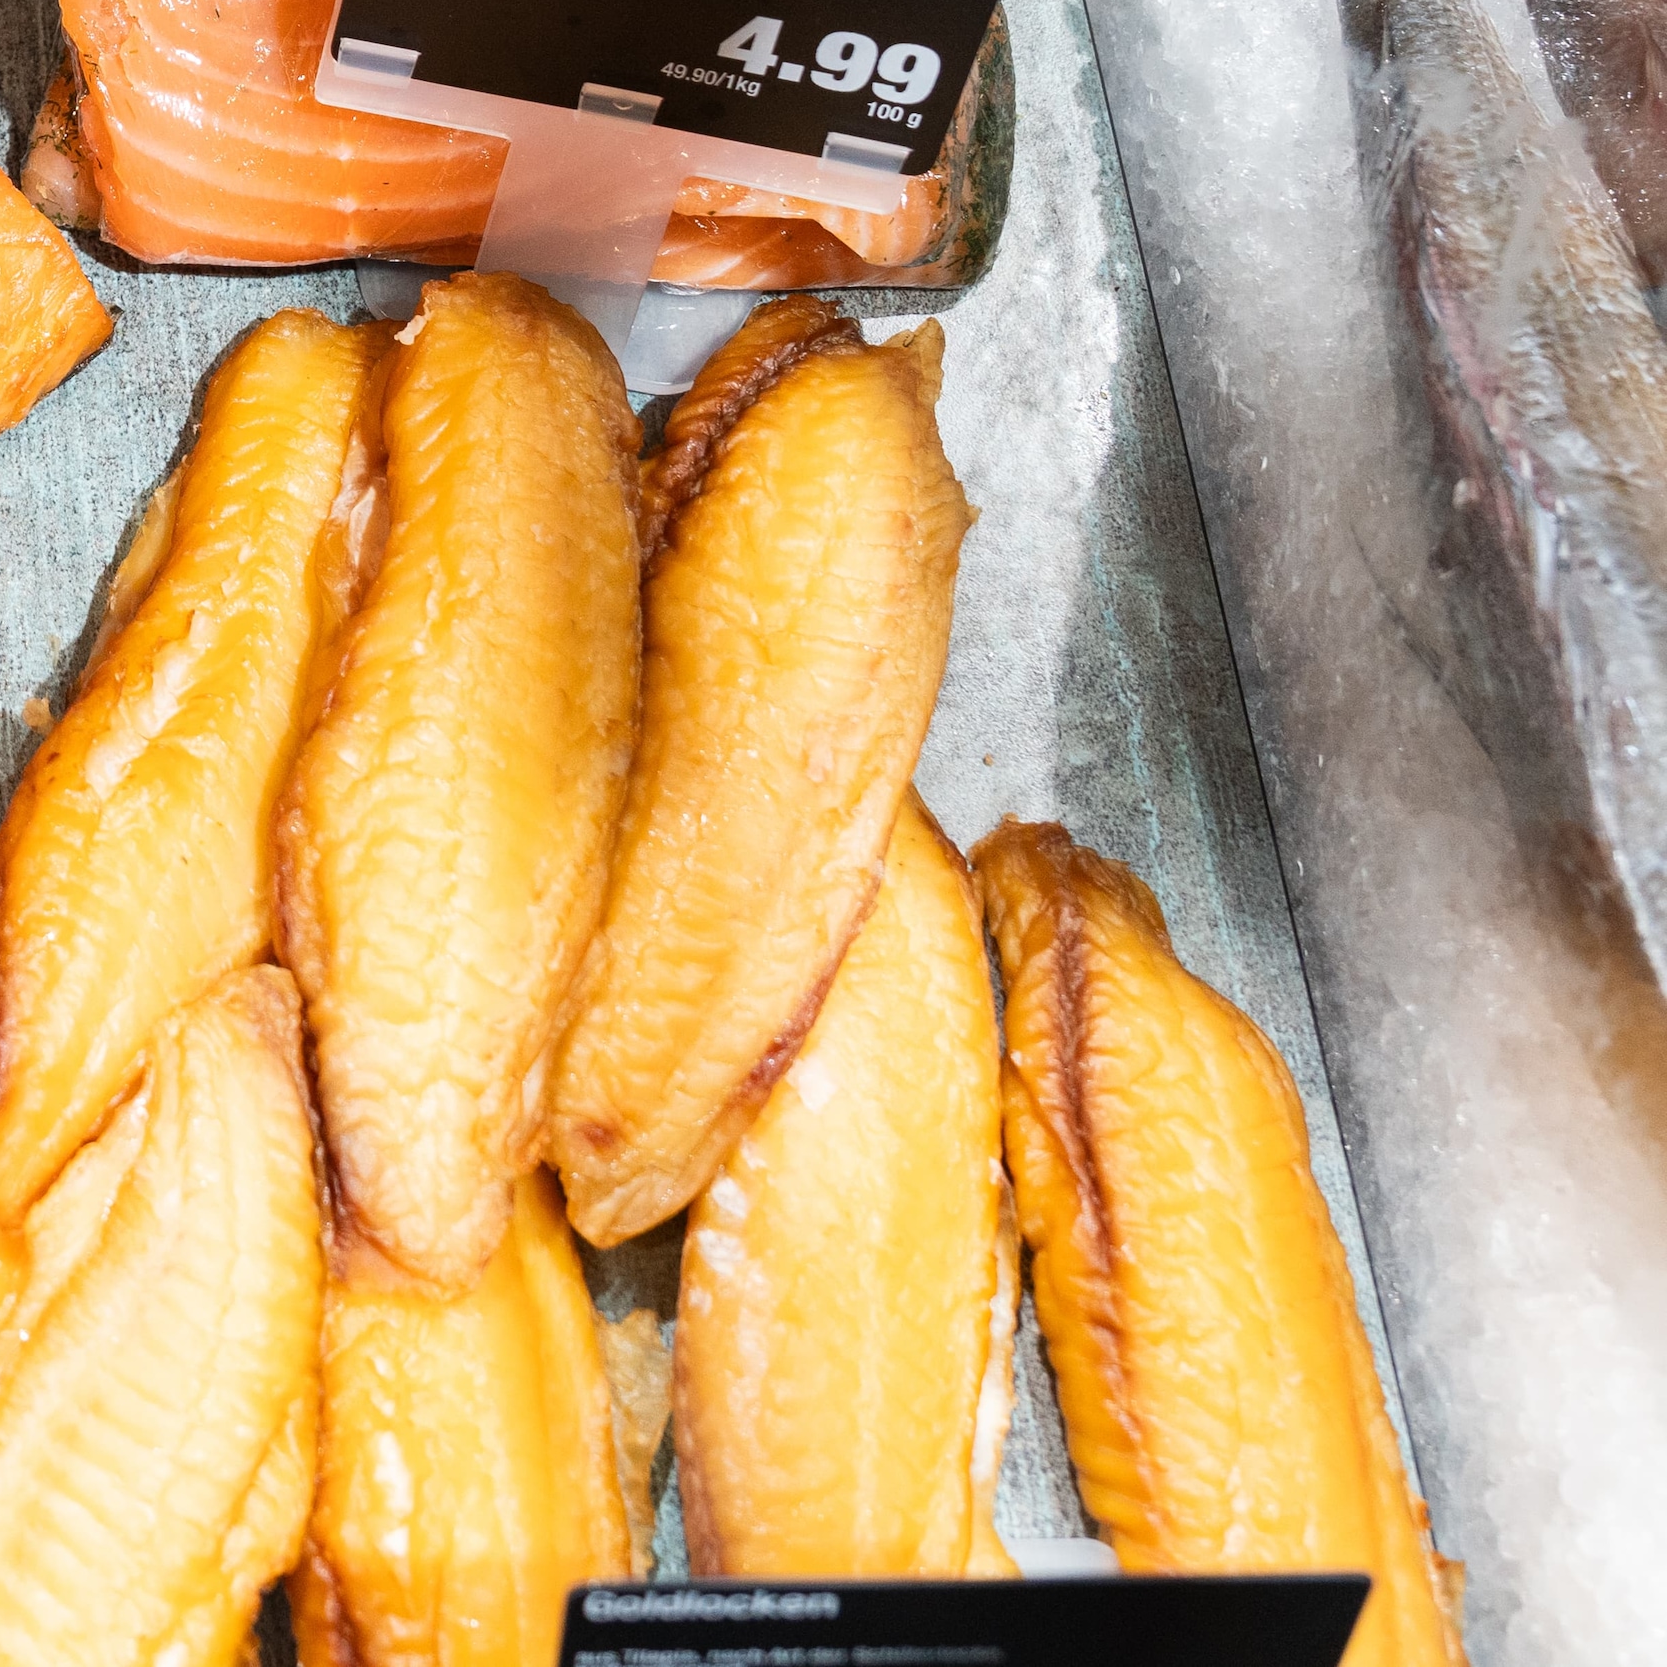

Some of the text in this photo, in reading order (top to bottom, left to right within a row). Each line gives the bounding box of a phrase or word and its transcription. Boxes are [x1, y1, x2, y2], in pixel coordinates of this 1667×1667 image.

[717, 16, 941, 105] 4.99
[660, 62, 762, 98] 49.90/1kg
[867, 101, 923, 129] 100 g
